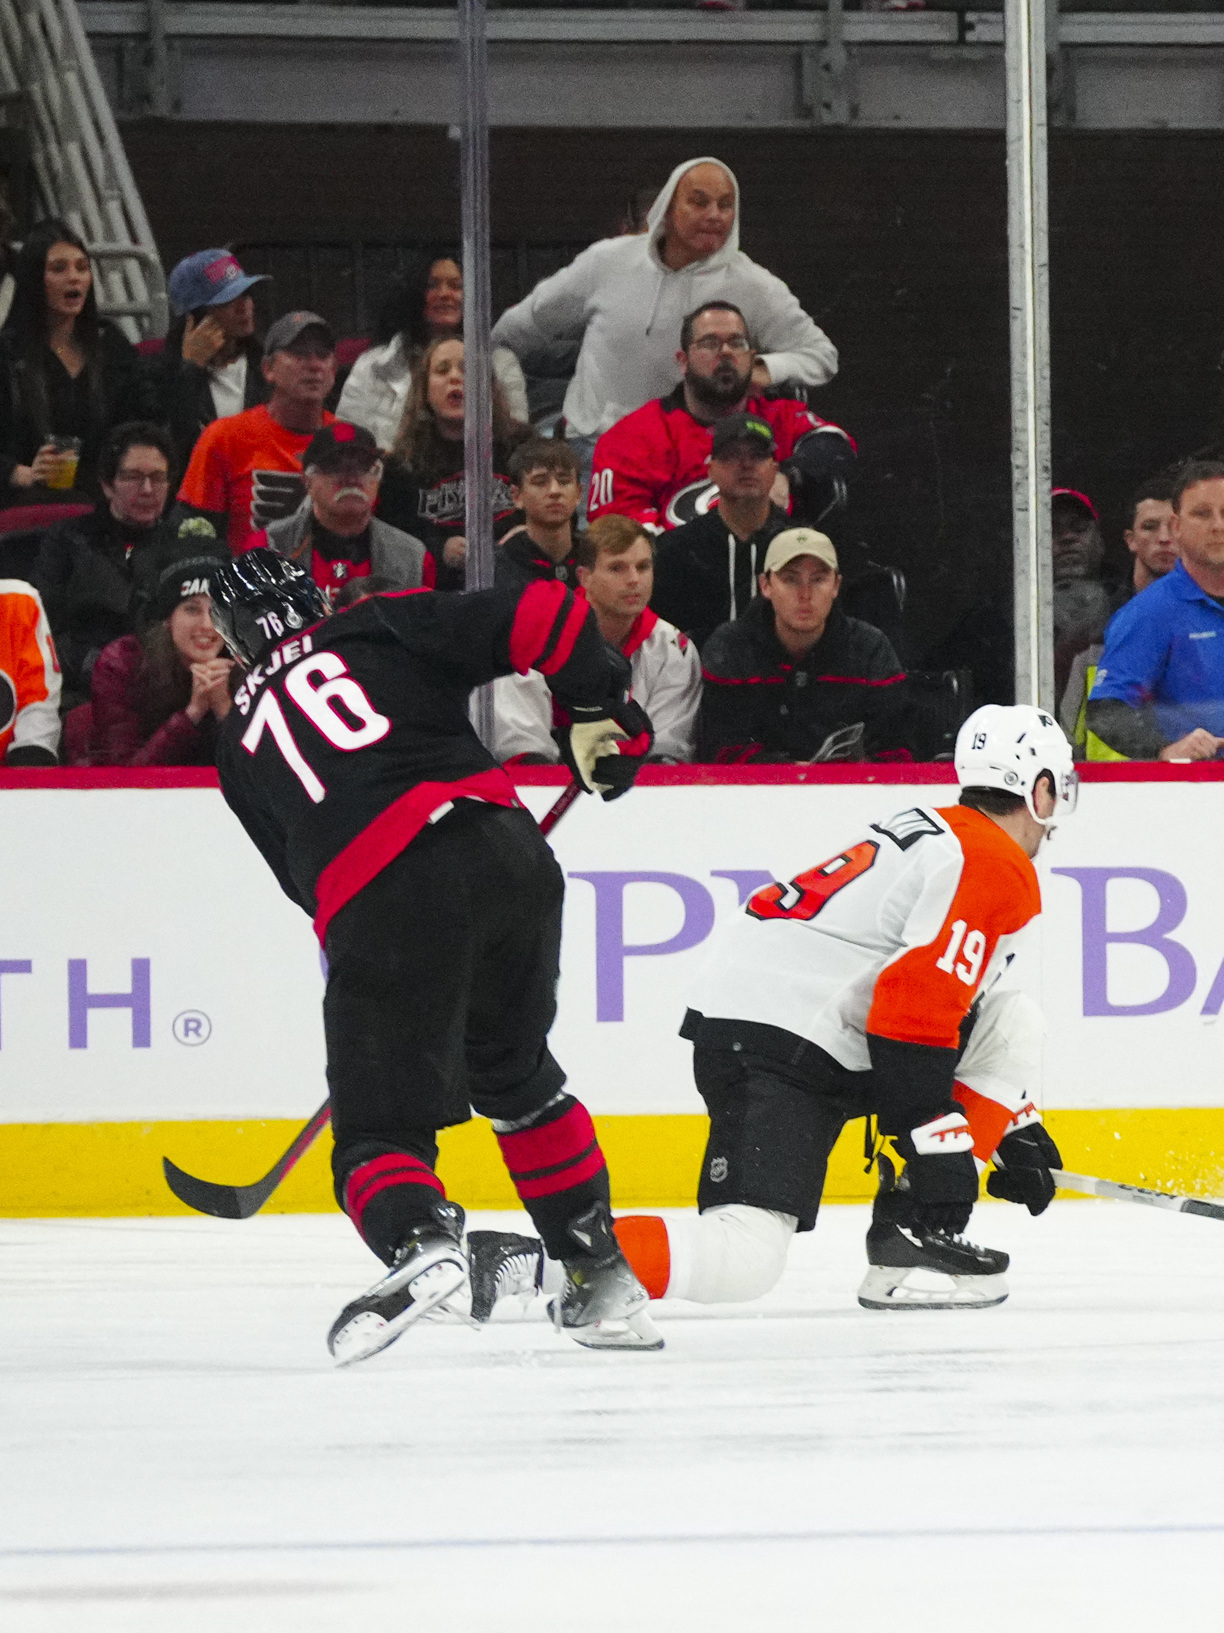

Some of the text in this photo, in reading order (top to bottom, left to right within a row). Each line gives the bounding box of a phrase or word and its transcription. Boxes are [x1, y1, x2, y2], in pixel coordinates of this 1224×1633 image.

[590, 468, 613, 511] 20
[255, 611, 285, 640] 76
[234, 634, 313, 716] SKJEI
[240, 650, 393, 804] 76
[971, 732, 988, 750] 19
[936, 919, 987, 986] 19
